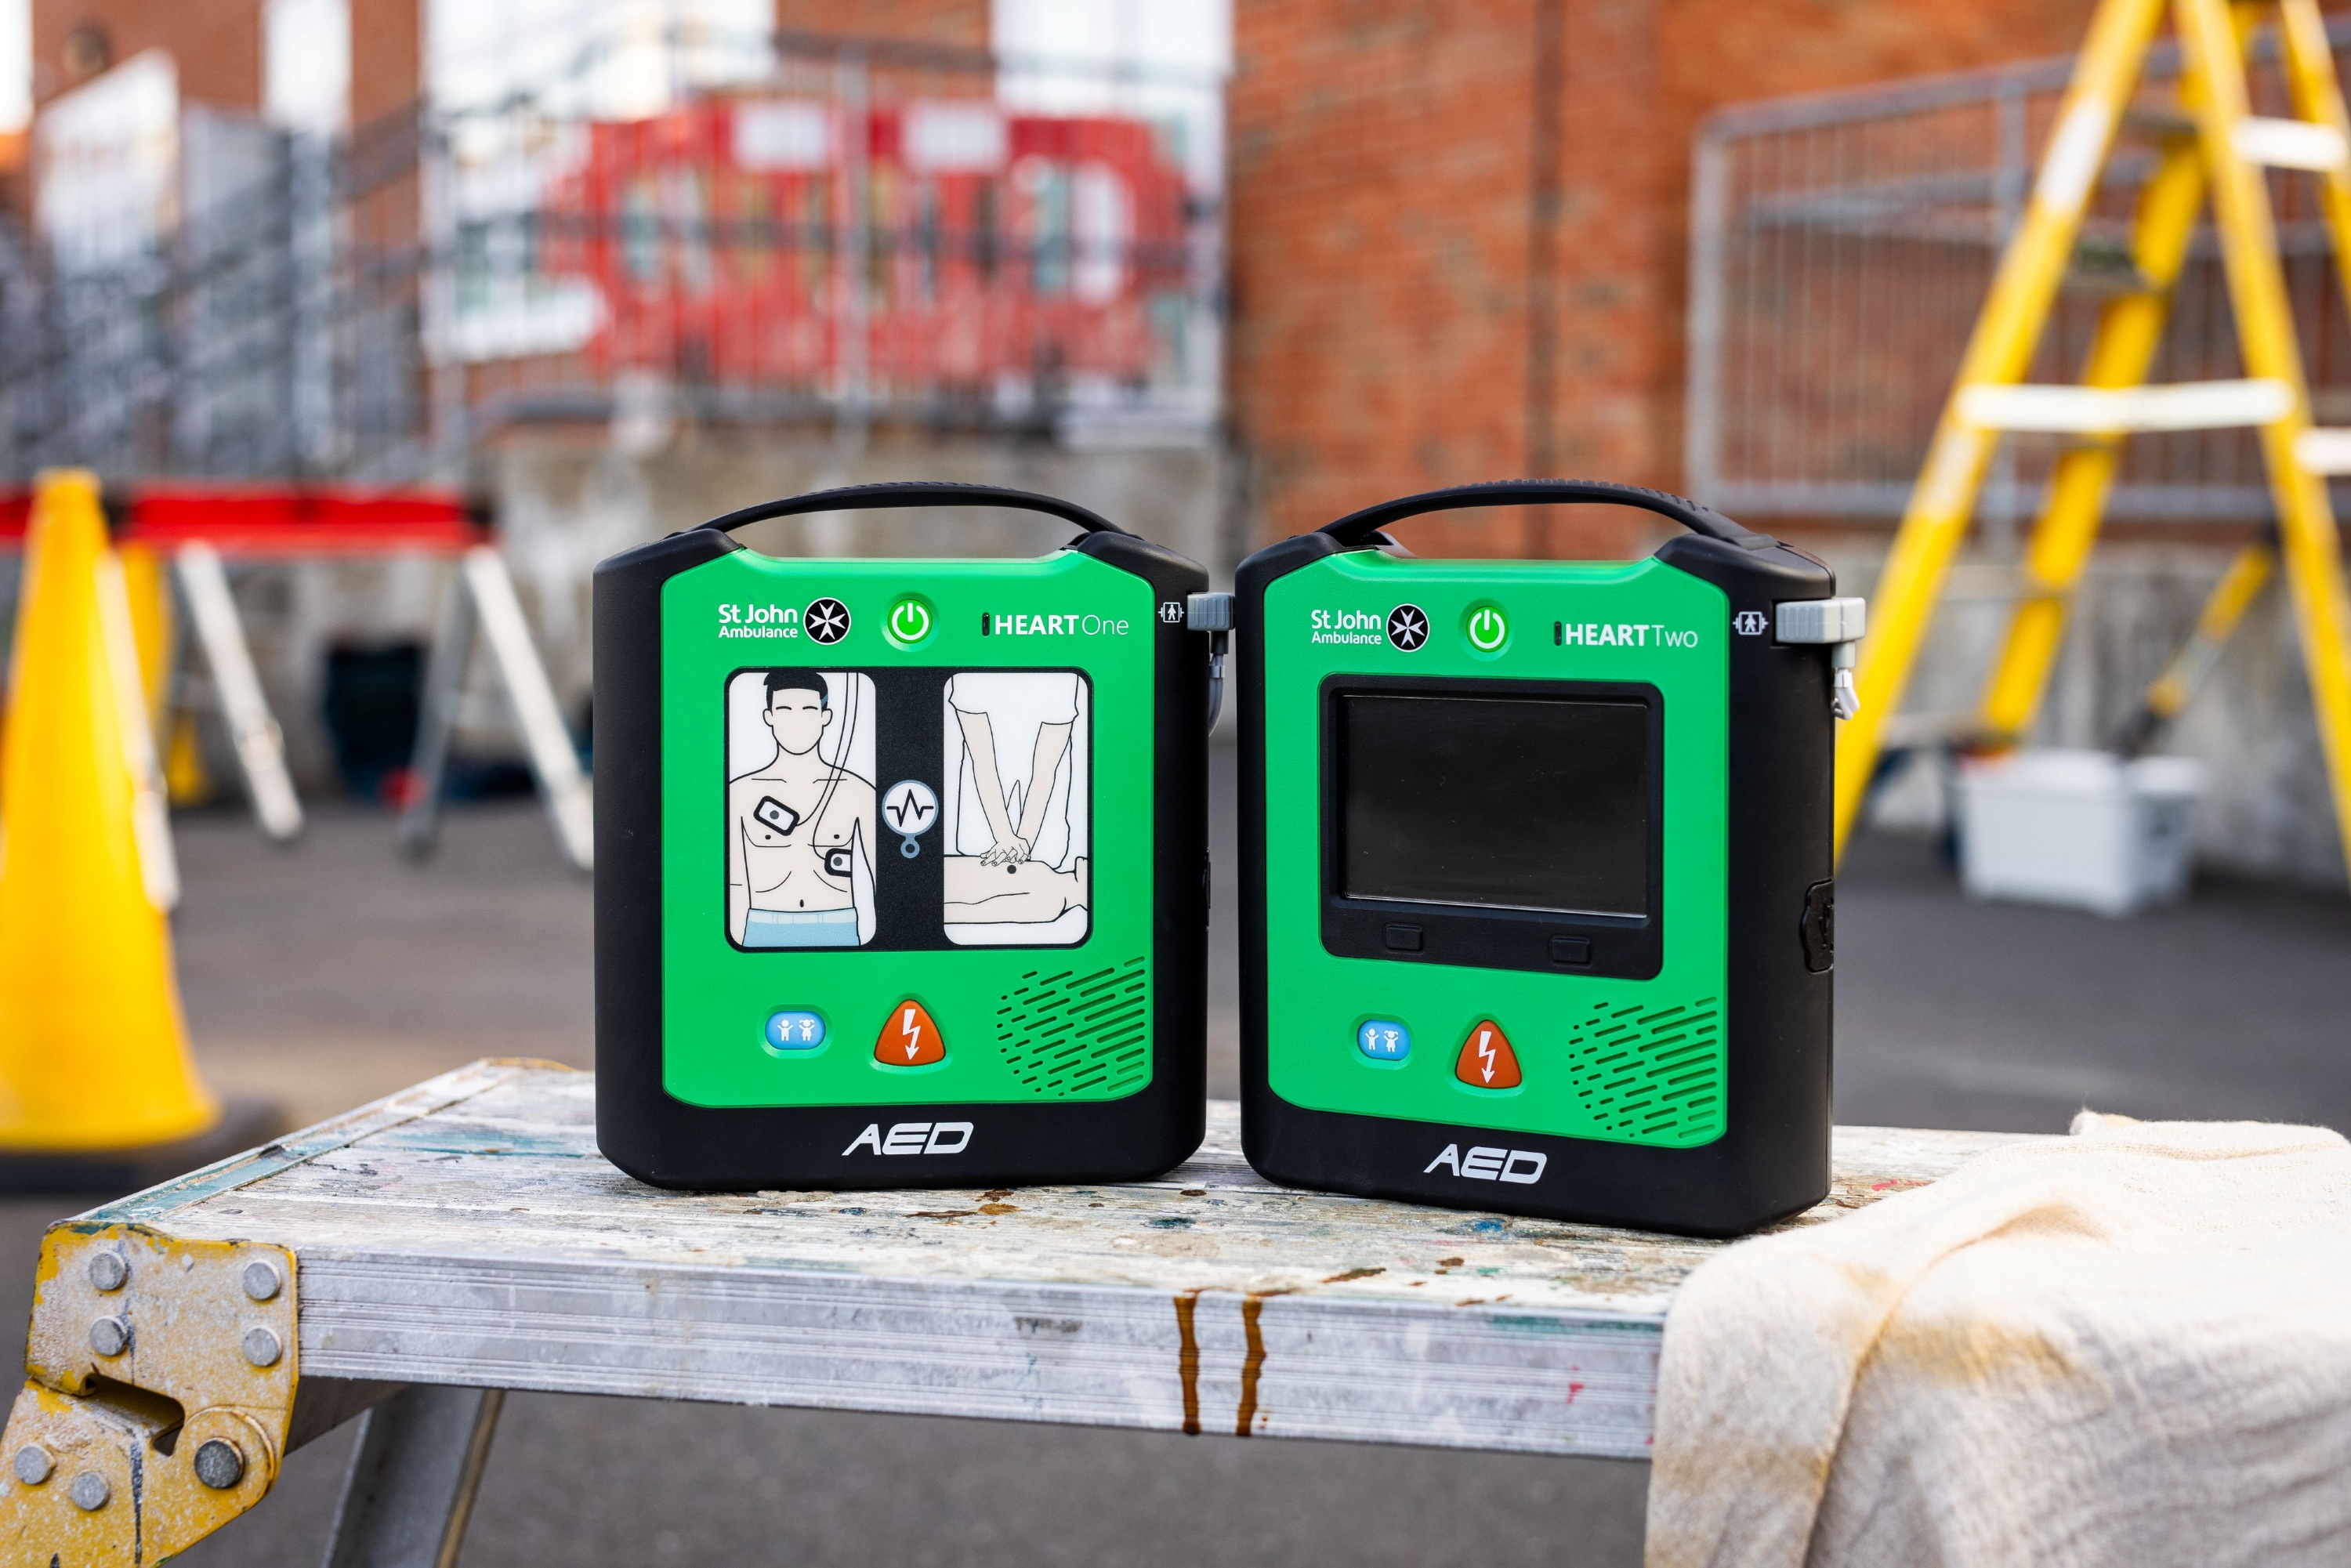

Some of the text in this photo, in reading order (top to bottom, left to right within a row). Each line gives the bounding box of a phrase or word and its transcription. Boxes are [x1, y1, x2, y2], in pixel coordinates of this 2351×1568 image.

[718, 603, 798, 624] St John
[1310, 609, 1382, 630] St John
[718, 625, 799, 639] Ambulance
[1081, 614, 1129, 636] One
[1311, 630, 1382, 645] Ambulance
[1650, 624, 1698, 648] Two
[841, 1121, 974, 1156] AED
[1422, 1143, 1548, 1185] AED
